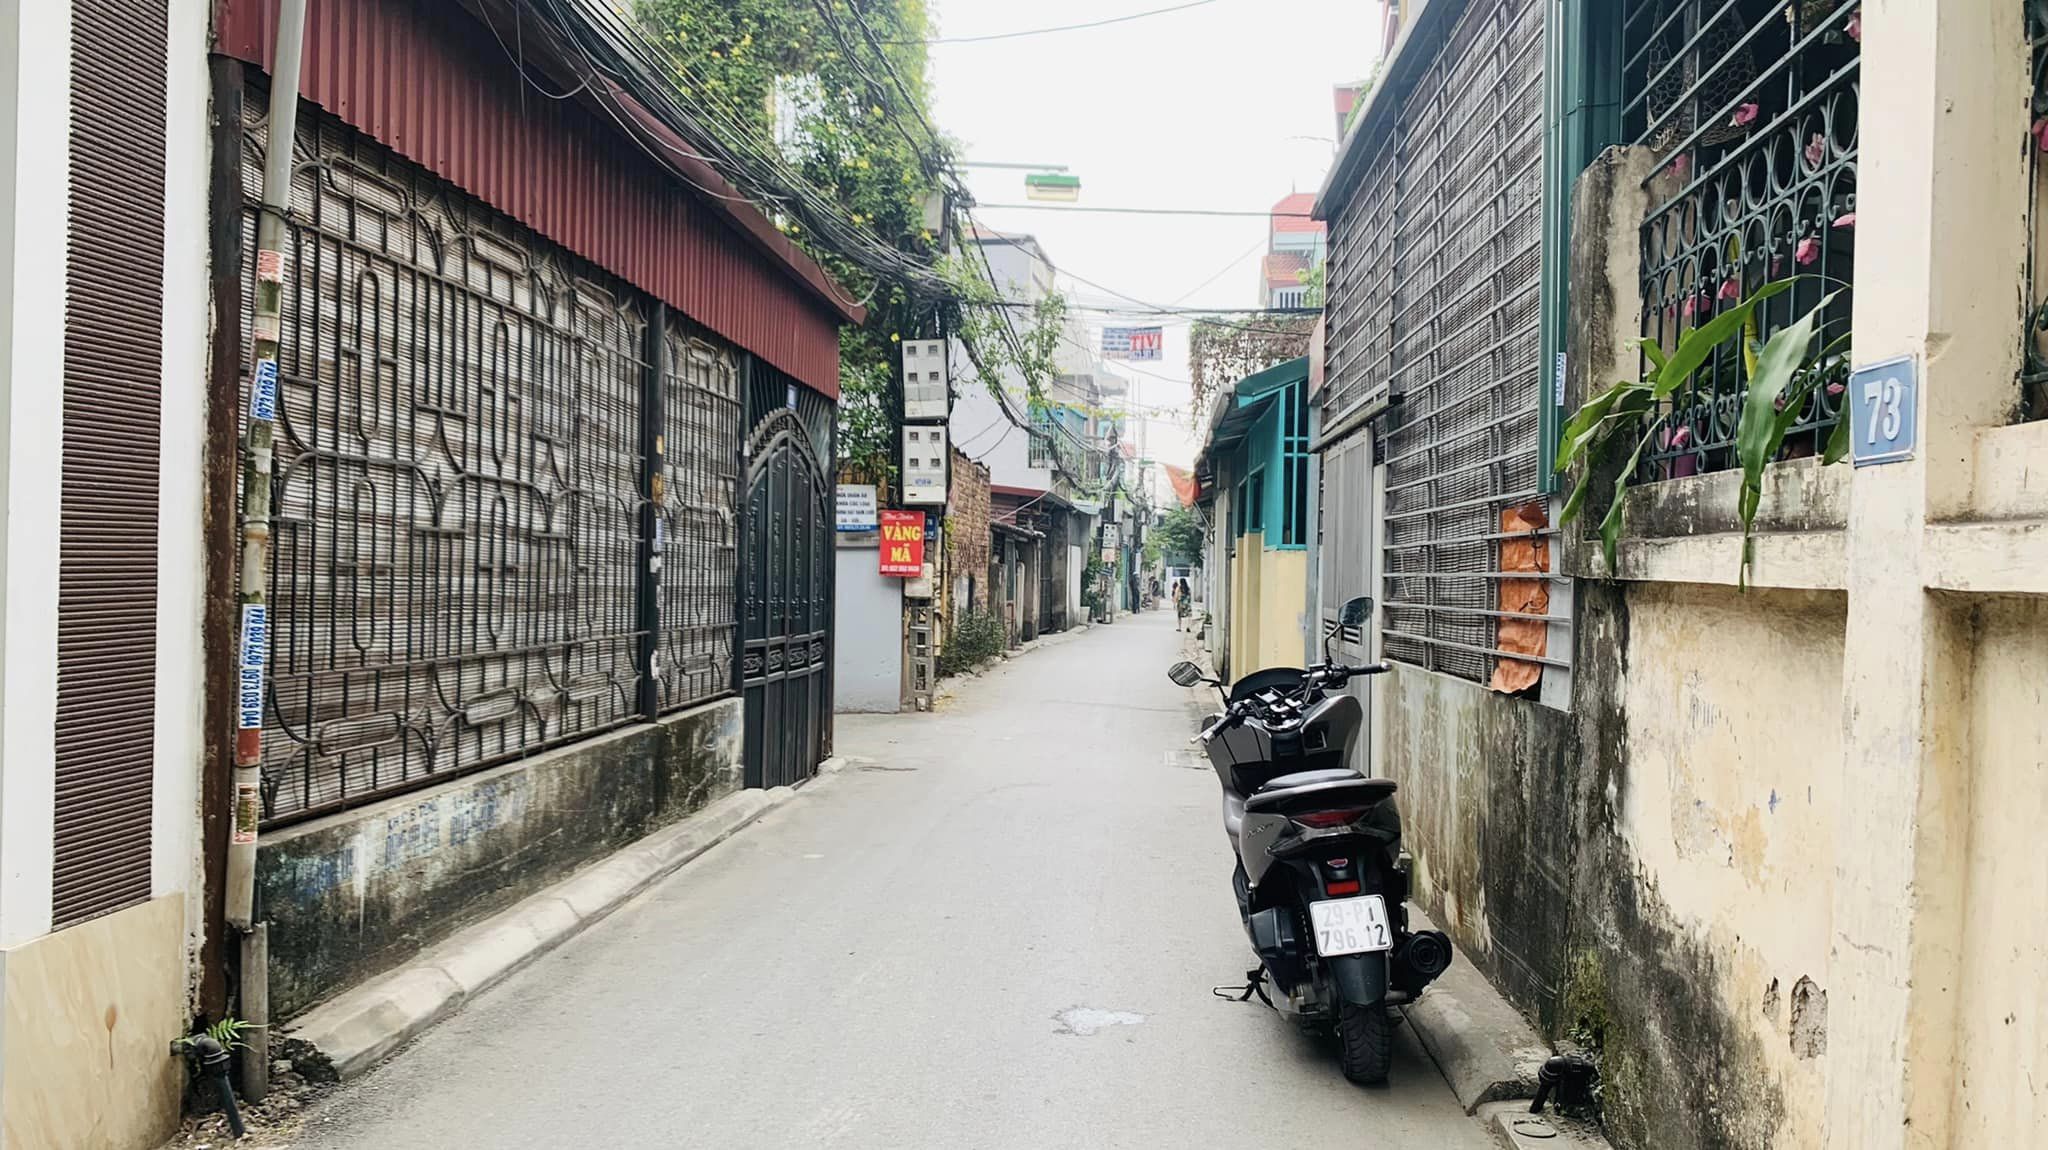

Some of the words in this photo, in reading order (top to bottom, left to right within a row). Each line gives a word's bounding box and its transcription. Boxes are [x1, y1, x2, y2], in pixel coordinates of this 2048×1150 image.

[1864, 377, 1901, 445] 73
[883, 521, 921, 540] VÀNG
[891, 543, 911, 562] MÃ
[241, 669, 260, 690] 0973
[241, 692, 260, 708] 039
[1319, 924, 1387, 953] 796.12
